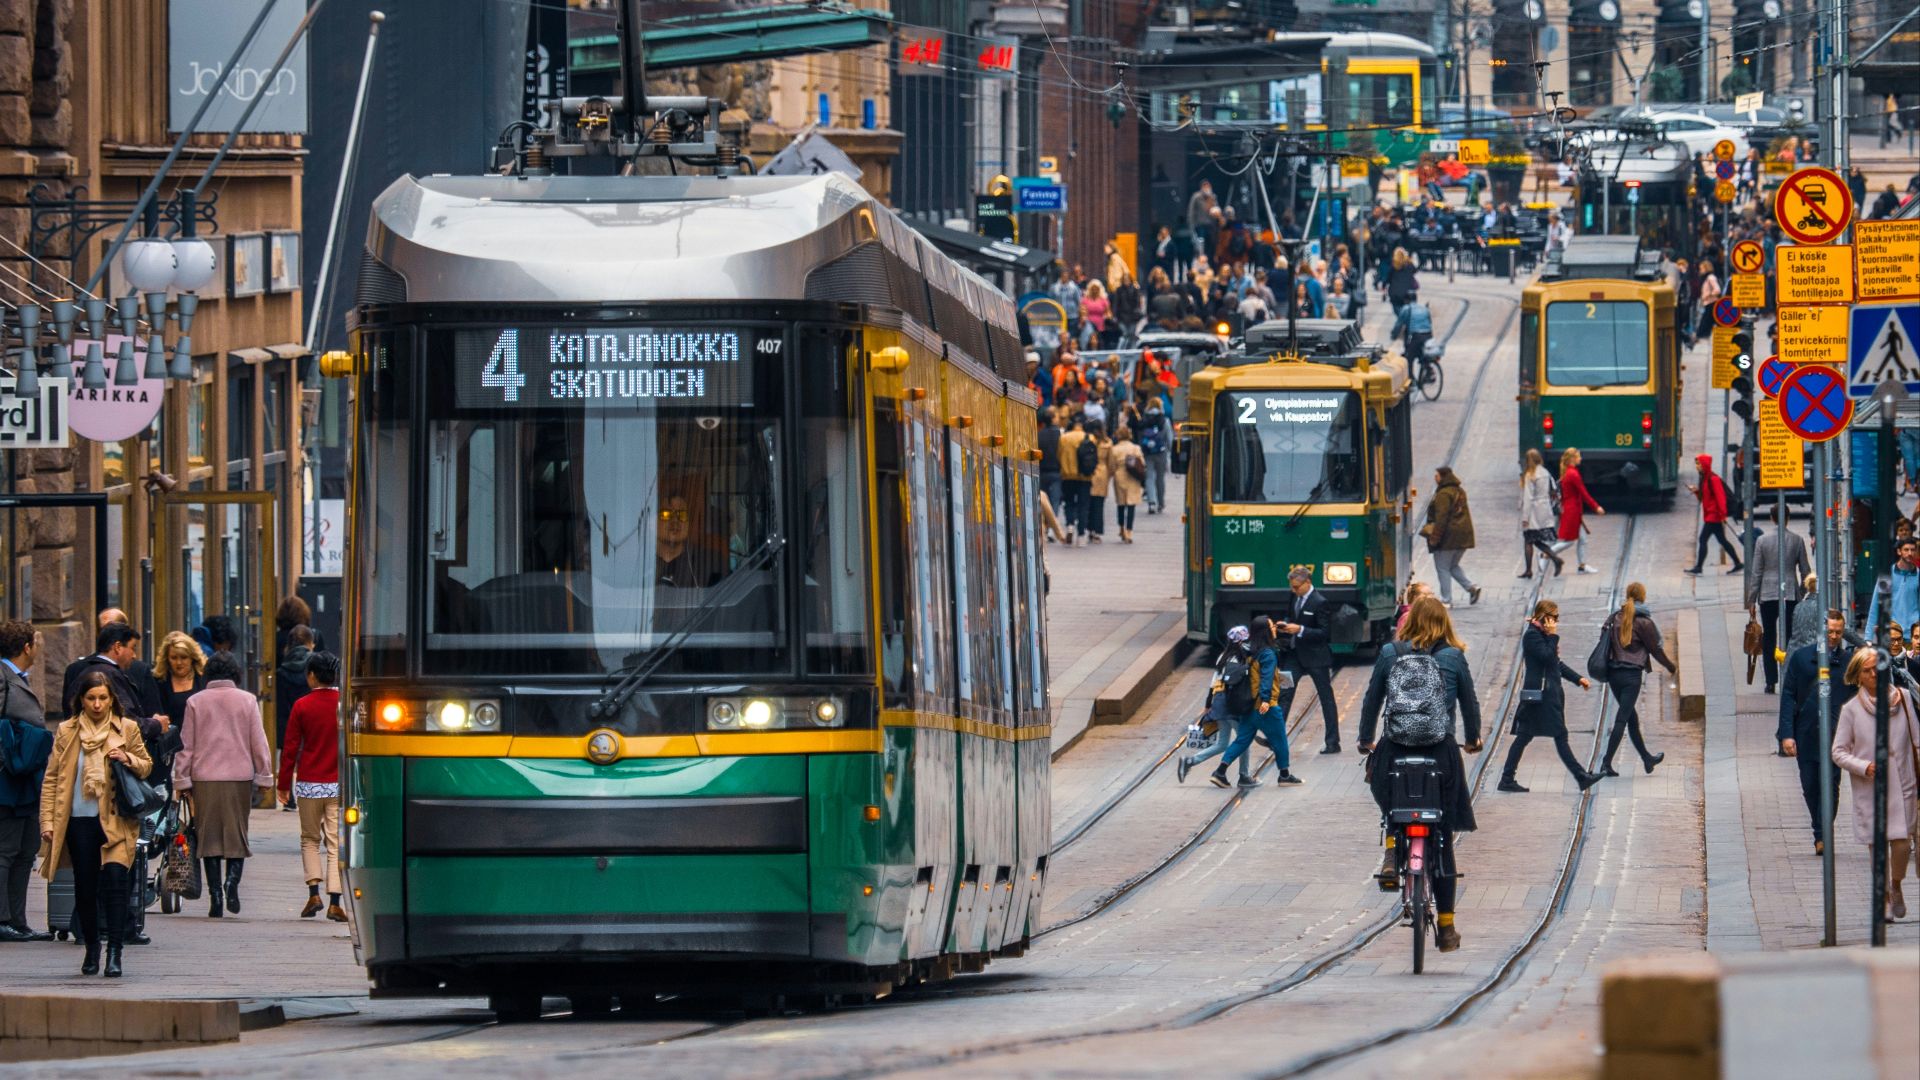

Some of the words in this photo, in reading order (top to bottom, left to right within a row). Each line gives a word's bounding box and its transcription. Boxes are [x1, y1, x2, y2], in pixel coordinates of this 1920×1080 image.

[525, 49, 536, 143] GLLERIA
[1859, 245, 1887, 254] sallittu
[1787, 251, 1796, 261] Ei
[1800, 251, 1827, 261] koske
[1787, 264, 1826, 275] -takseja
[1862, 265, 1902, 275] purkaville
[1788, 276, 1840, 288] -huoltoajoa
[1863, 275, 1912, 286] ajoneuvoille
[1788, 288, 1844, 298] -tontilleajoa
[1585, 303, 1596, 318] 2
[1780, 311, 1807, 321] Gäller
[1811, 311, 1820, 321] ej
[1780, 323, 1801, 333] -taxi
[1781, 335, 1847, 345] -servicekörnin
[550, 334, 738, 362] KATAJANOKKA
[757, 339, 782, 354] 407
[481, 328, 525, 402] 4
[1738, 354, 1751, 369] S
[550, 368, 705, 398] SKATUDDEN
[1237, 397, 1257, 424] 2
[1264, 397, 1338, 410] Olympiaterminaali
[1269, 412, 1284, 422] via
[1285, 411, 1332, 424] Kauppatori
[1615, 433, 1632, 446] 89
